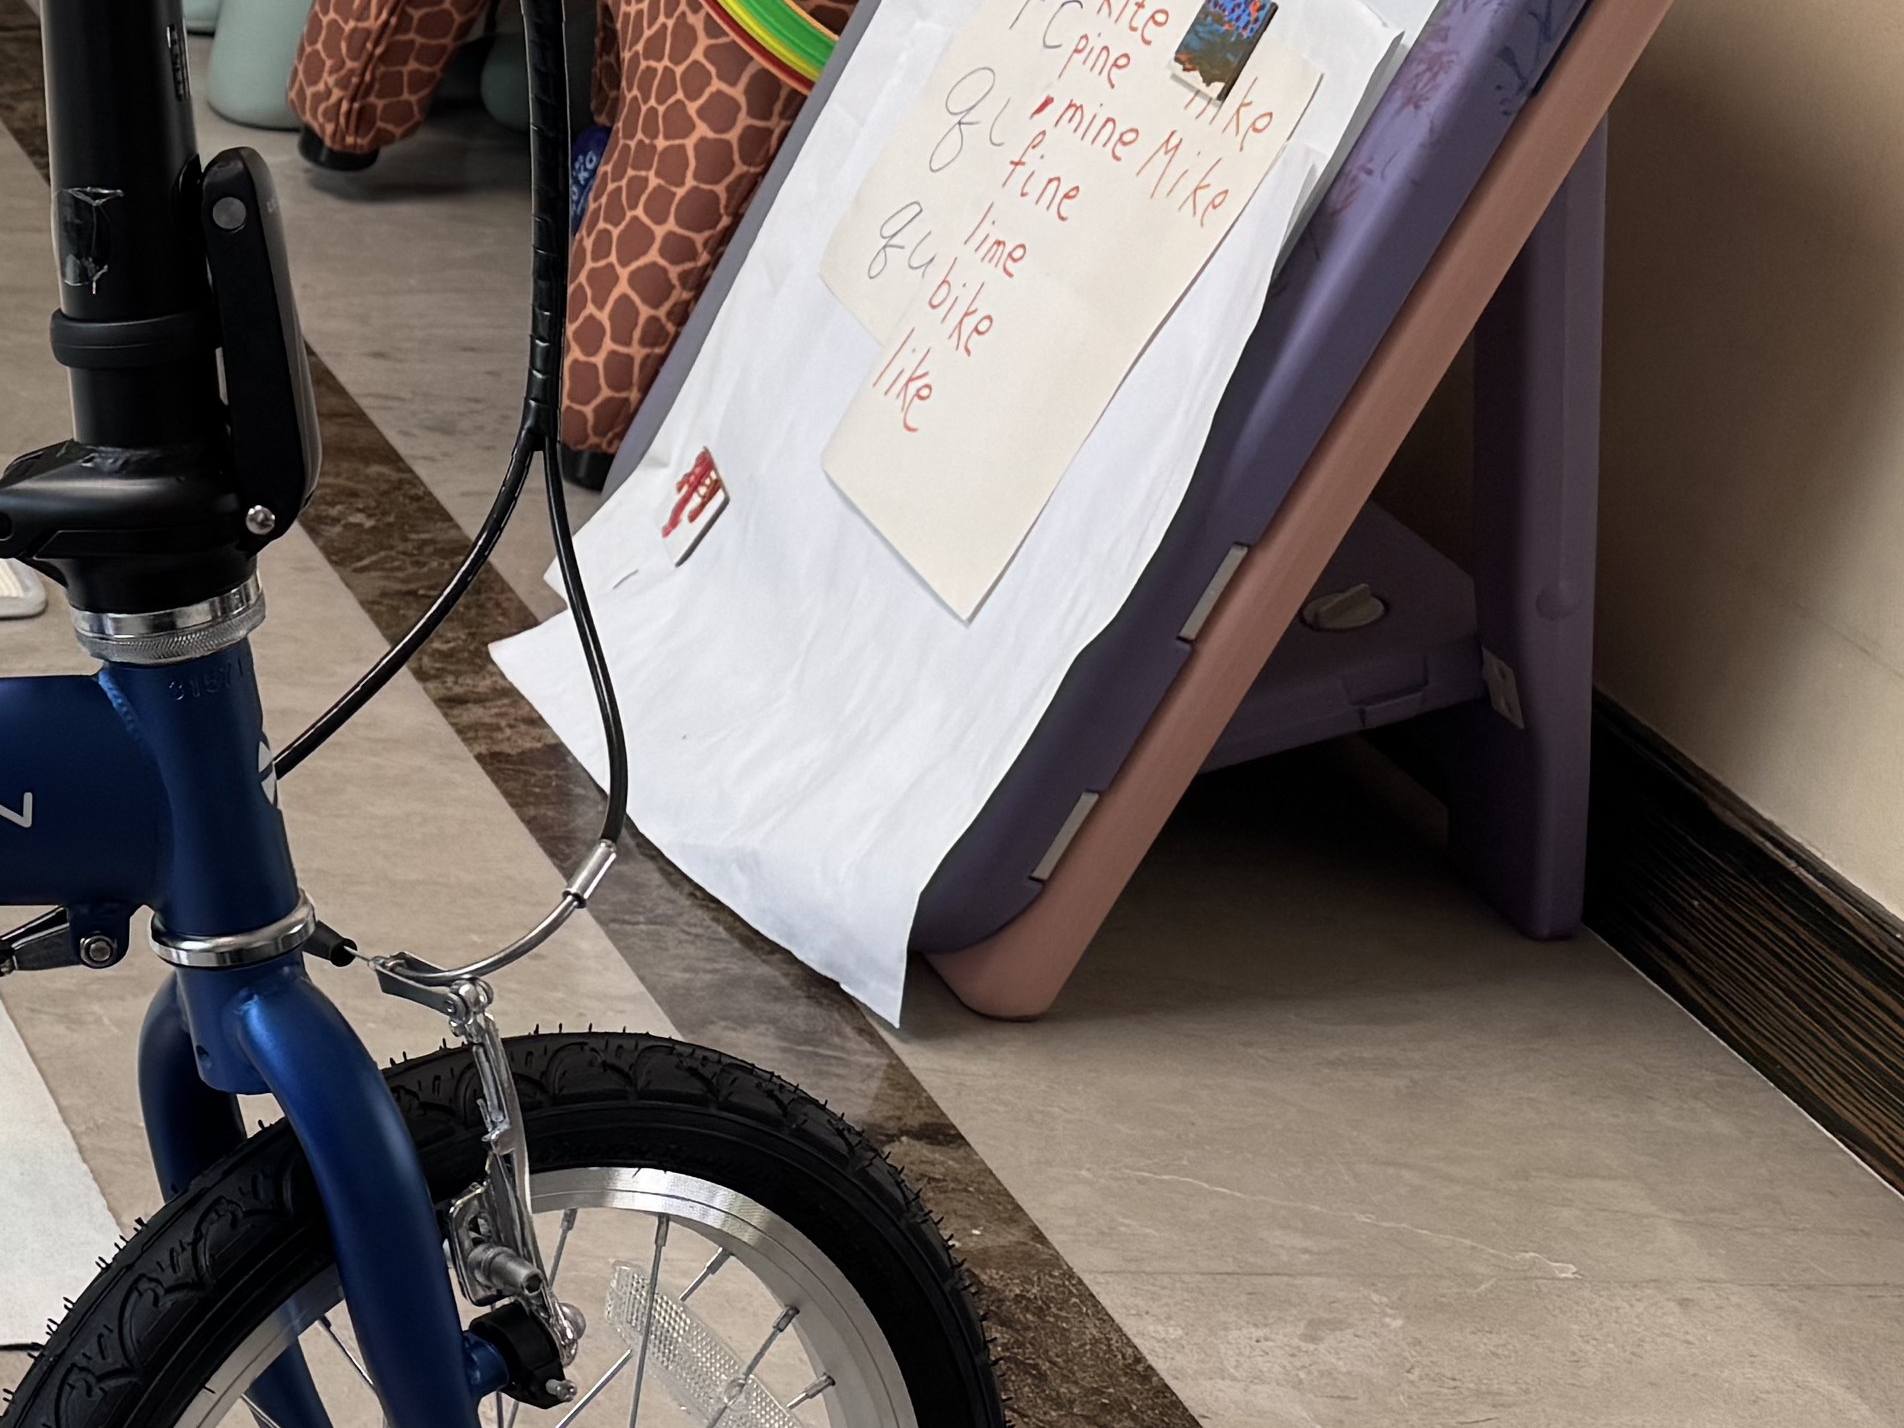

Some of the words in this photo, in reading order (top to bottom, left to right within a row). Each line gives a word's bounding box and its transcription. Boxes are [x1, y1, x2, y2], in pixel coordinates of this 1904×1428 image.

[1002, 129, 1080, 222] fine
[928, 257, 994, 357] bike
[872, 327, 933, 433] like
